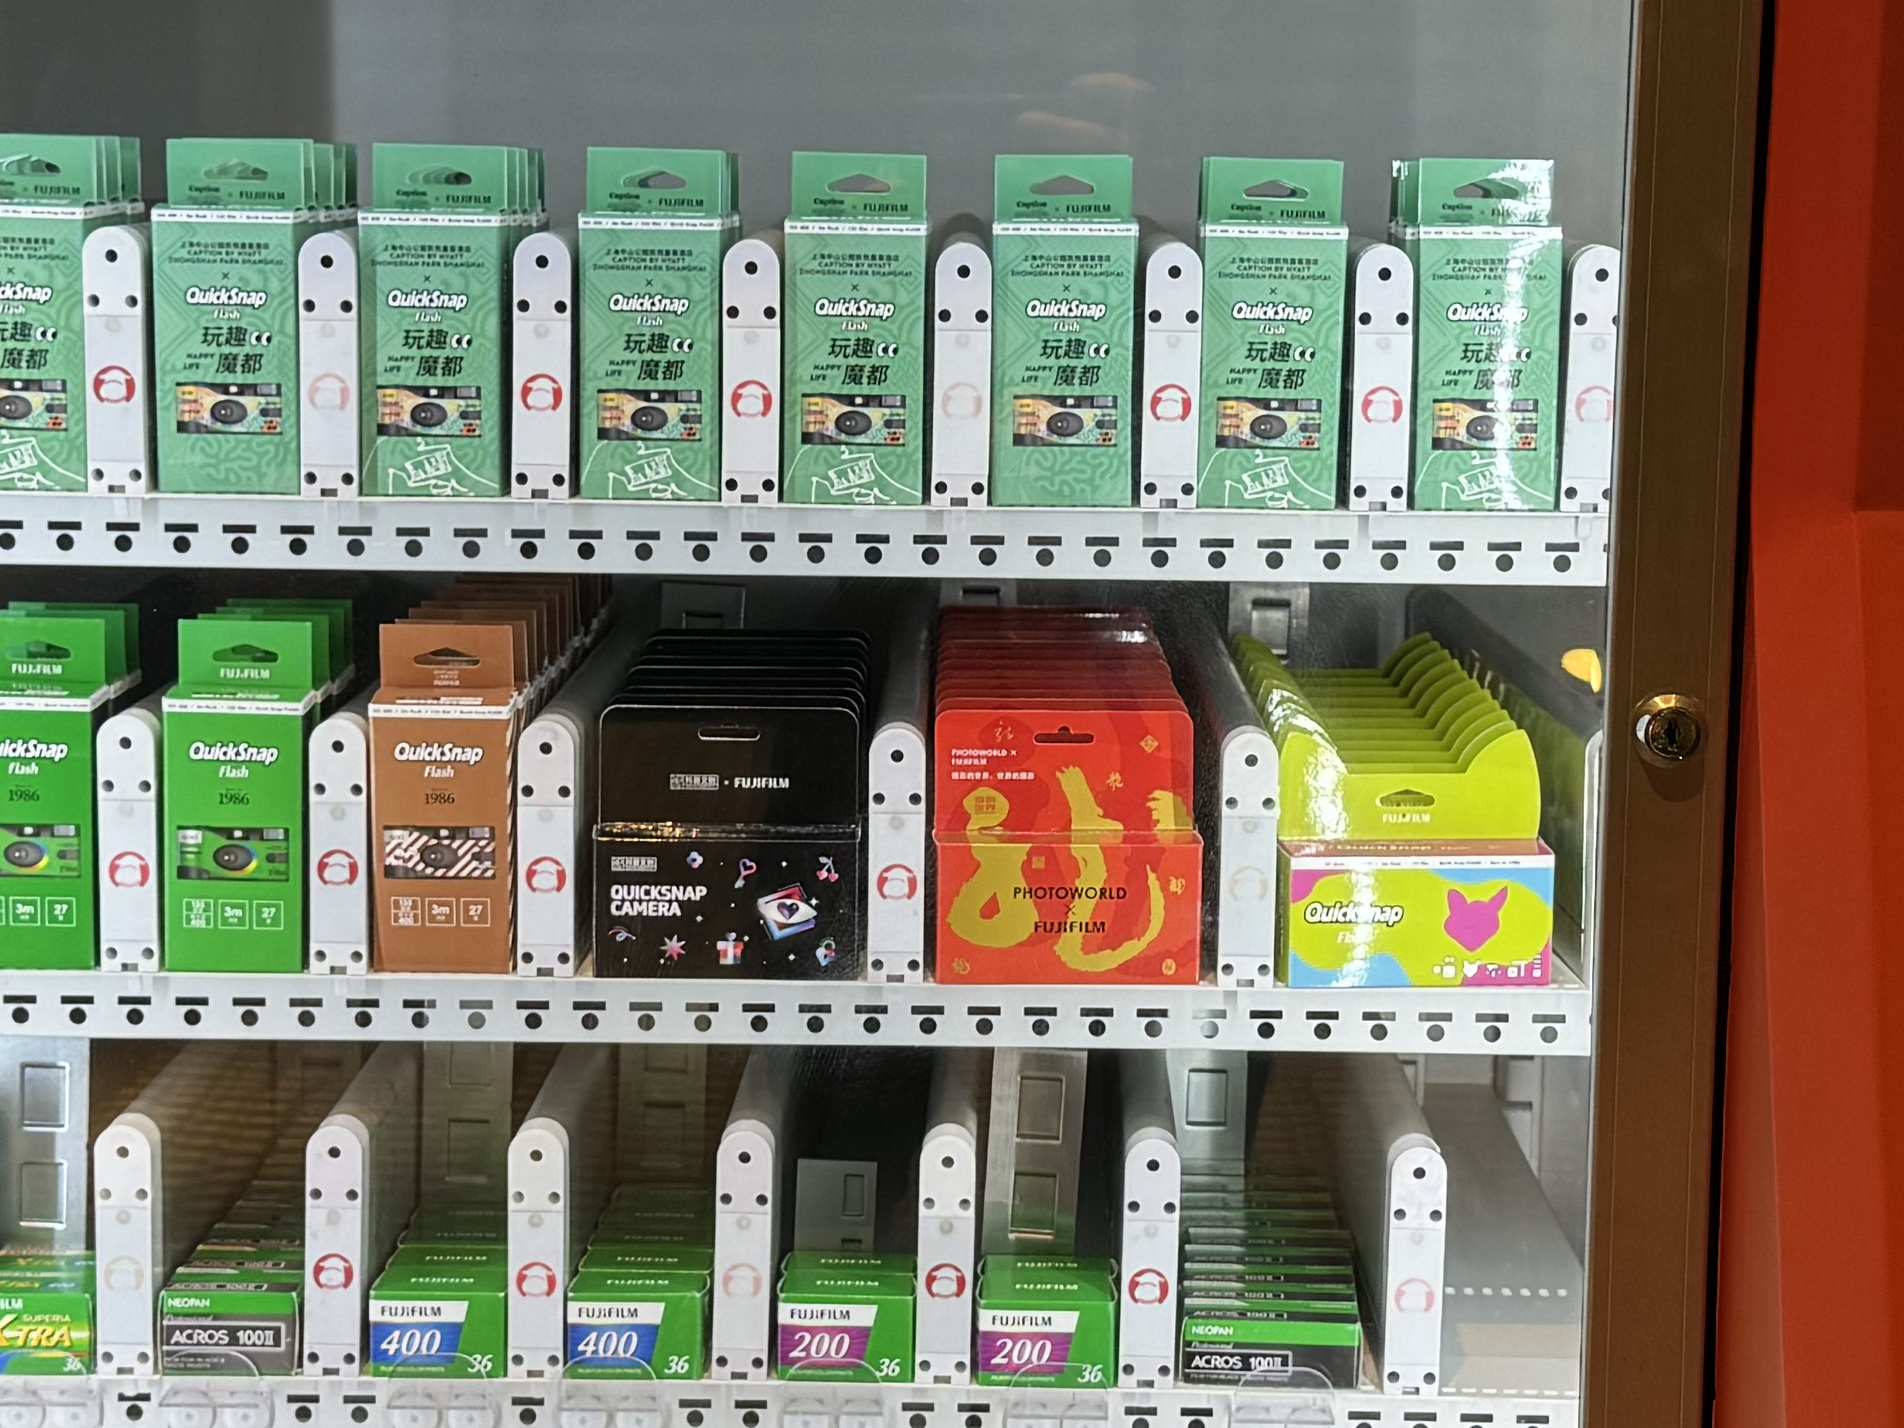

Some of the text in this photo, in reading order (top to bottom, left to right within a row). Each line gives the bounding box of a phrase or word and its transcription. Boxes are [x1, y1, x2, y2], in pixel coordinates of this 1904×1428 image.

[185, 286, 267, 308] QuickSnap
[388, 289, 468, 312] QuickSnap
[609, 293, 690, 315] QuickSnap
[814, 298, 895, 320] QuickSnap
[1026, 299, 1107, 322] QuickSnap
[1232, 301, 1313, 324] QuickSnap
[202, 326, 247, 348] 玩趣
[402, 329, 448, 350] 玩趣
[624, 333, 669, 354] 玩趣
[828, 338, 874, 359] 玩趣
[1041, 339, 1086, 360] 玩趣
[1246, 341, 1292, 363] 玩趣
[1, 348, 49, 370] 魔都
[216, 353, 264, 375] 魔都
[416, 356, 464, 378] 魔都
[638, 360, 684, 381] 魔都
[842, 365, 890, 385] 魔都
[1054, 365, 1101, 387] 魔都
[1258, 368, 1306, 390] 魔都
[189, 741, 279, 765] QuickSnap
[394, 742, 484, 765] QuickSnap
[8, 761, 39, 776] Flash
[218, 765, 249, 779] Flash
[424, 765, 455, 779] Flash
[734, 776, 790, 789] FUJIFILM
[8, 788, 40, 803] 1986
[218, 791, 250, 806] 1986
[424, 792, 455, 806] 1986
[610, 884, 708, 902] QUICKSNAP
[1013, 886, 1128, 901] PHOTOWORLD
[53, 903, 69, 916] 27
[610, 901, 683, 917] CAMERA
[1034, 920, 1106, 934] FUJIFILM
[167, 1298, 211, 1308] NEOPAN
[380, 1305, 442, 1317] FUJIFILM
[577, 1307, 639, 1319] FUJIFILM
[22, 1313, 71, 1323] SUPERIA
[789, 1308, 851, 1321] FUJIFILM
[991, 1315, 1053, 1327] FUJIFILM
[170, 1329, 230, 1345] ACROS
[1191, 1325, 1234, 1336] NEOPAN
[379, 1329, 441, 1357] 400
[577, 1330, 639, 1359] 400
[788, 1332, 850, 1358] 200
[990, 1338, 1053, 1365] 200
[467, 1354, 493, 1373] 36
[663, 1355, 690, 1374] 36
[875, 1358, 901, 1377] 36
[1191, 1355, 1243, 1370] ACROS
[1076, 1364, 1103, 1384] 36
